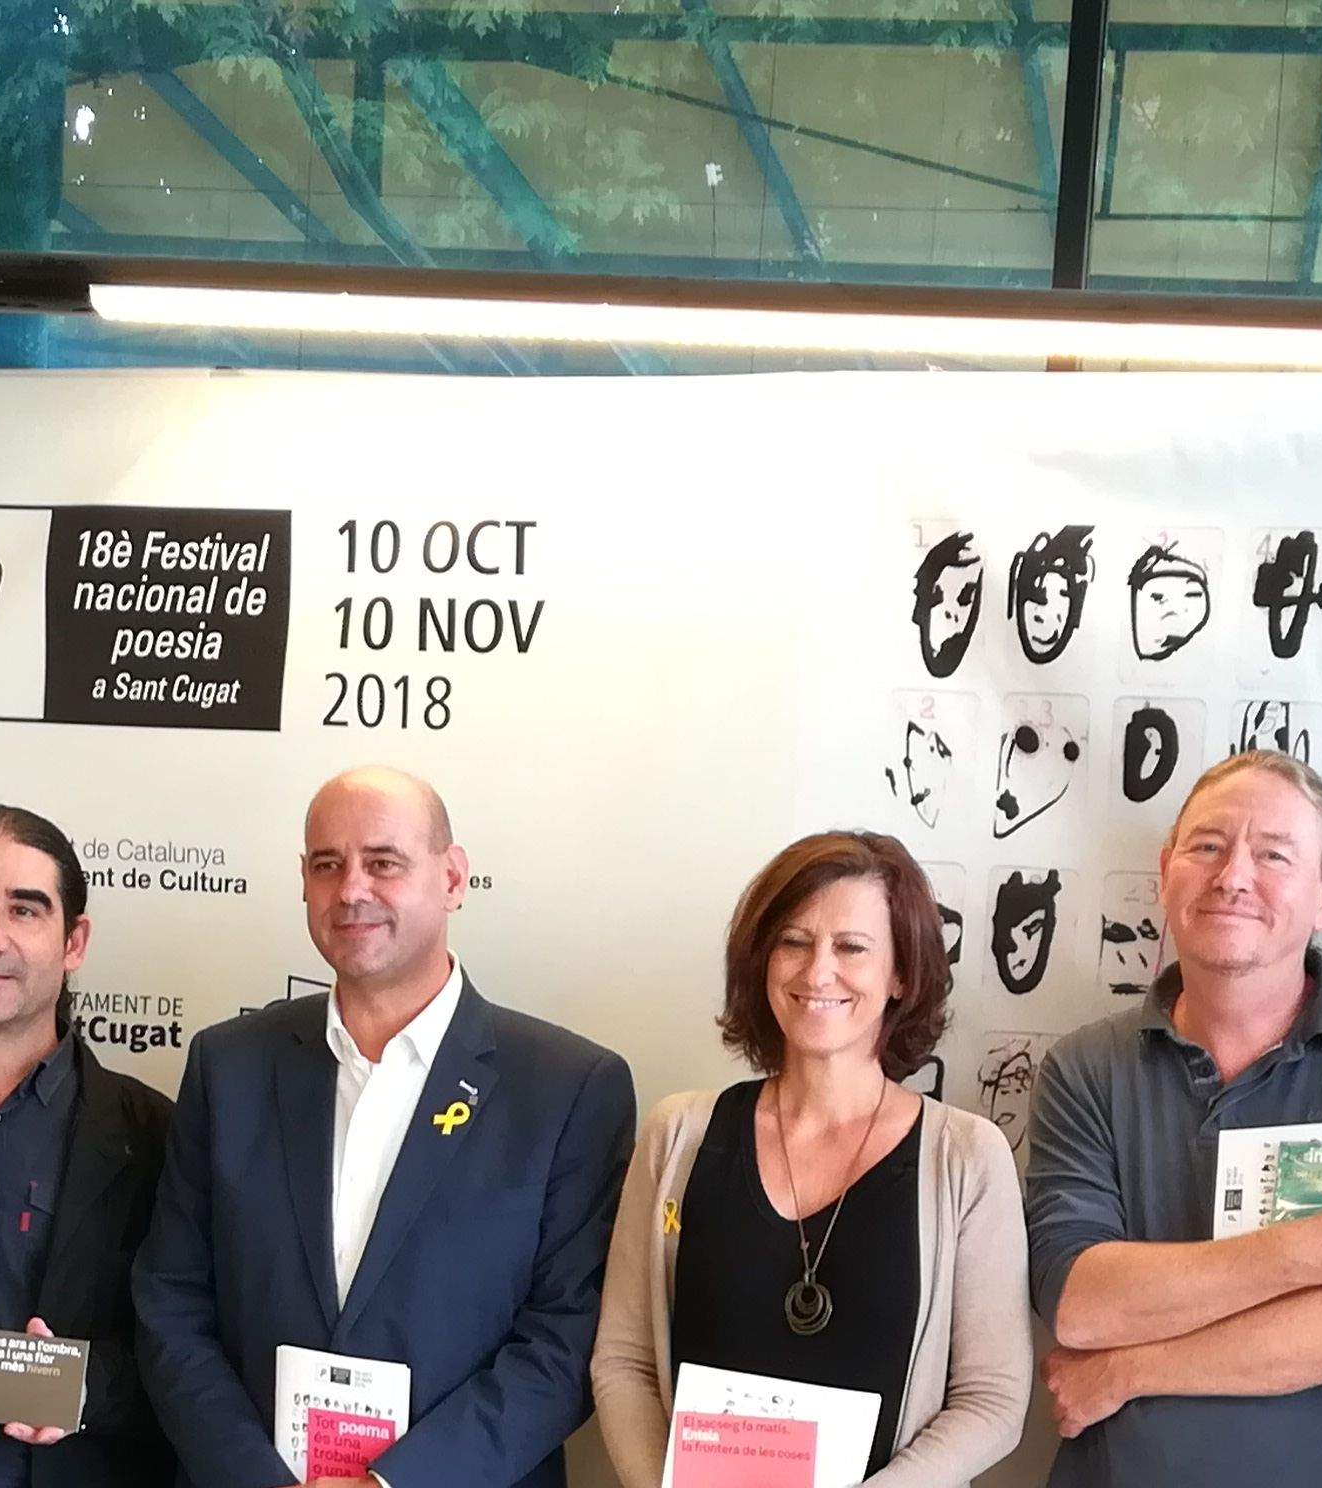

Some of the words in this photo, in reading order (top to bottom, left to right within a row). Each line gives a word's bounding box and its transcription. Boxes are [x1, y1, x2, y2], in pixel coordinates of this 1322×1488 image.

[77, 529, 133, 569] 18è
[141, 531, 271, 573] Festival
[338, 519, 401, 574] 10
[421, 520, 538, 577] OCT
[73, 577, 216, 615] nacional
[224, 578, 268, 616] de
[334, 597, 394, 651] 10
[418, 597, 545, 655] NOV
[111, 623, 224, 665] poesia
[92, 682, 106, 699] a
[112, 673, 166, 702] Sant
[171, 676, 241, 708] Cugat
[322, 672, 453, 731] 2018
[83, 841, 109, 860] de
[117, 839, 226, 869] Catalunya
[123, 867, 151, 889] de
[160, 869, 247, 894] Cultura
[71, 991, 151, 1015] TAMENT
[158, 996, 183, 1017] DE
[76, 1015, 182, 1053] tCugat
[8, 1338, 27, 1351] ara
[28, 1341, 36, 1351] a
[12, 1350, 33, 1362] una
[35, 1351, 55, 1364] flor
[0, 1359, 25, 1373] més
[314, 1414, 336, 1430] Tot
[338, 1420, 390, 1440] poema
[683, 1416, 695, 1428] El
[742, 1420, 753, 1431] fa
[314, 1431, 331, 1444] és
[334, 1436, 361, 1449] una
[682, 1441, 692, 1452] la
[695, 1441, 739, 1455] frontera
[743, 1446, 756, 1456] de
[759, 1446, 775, 1458] les
[777, 1449, 810, 1461] coses
